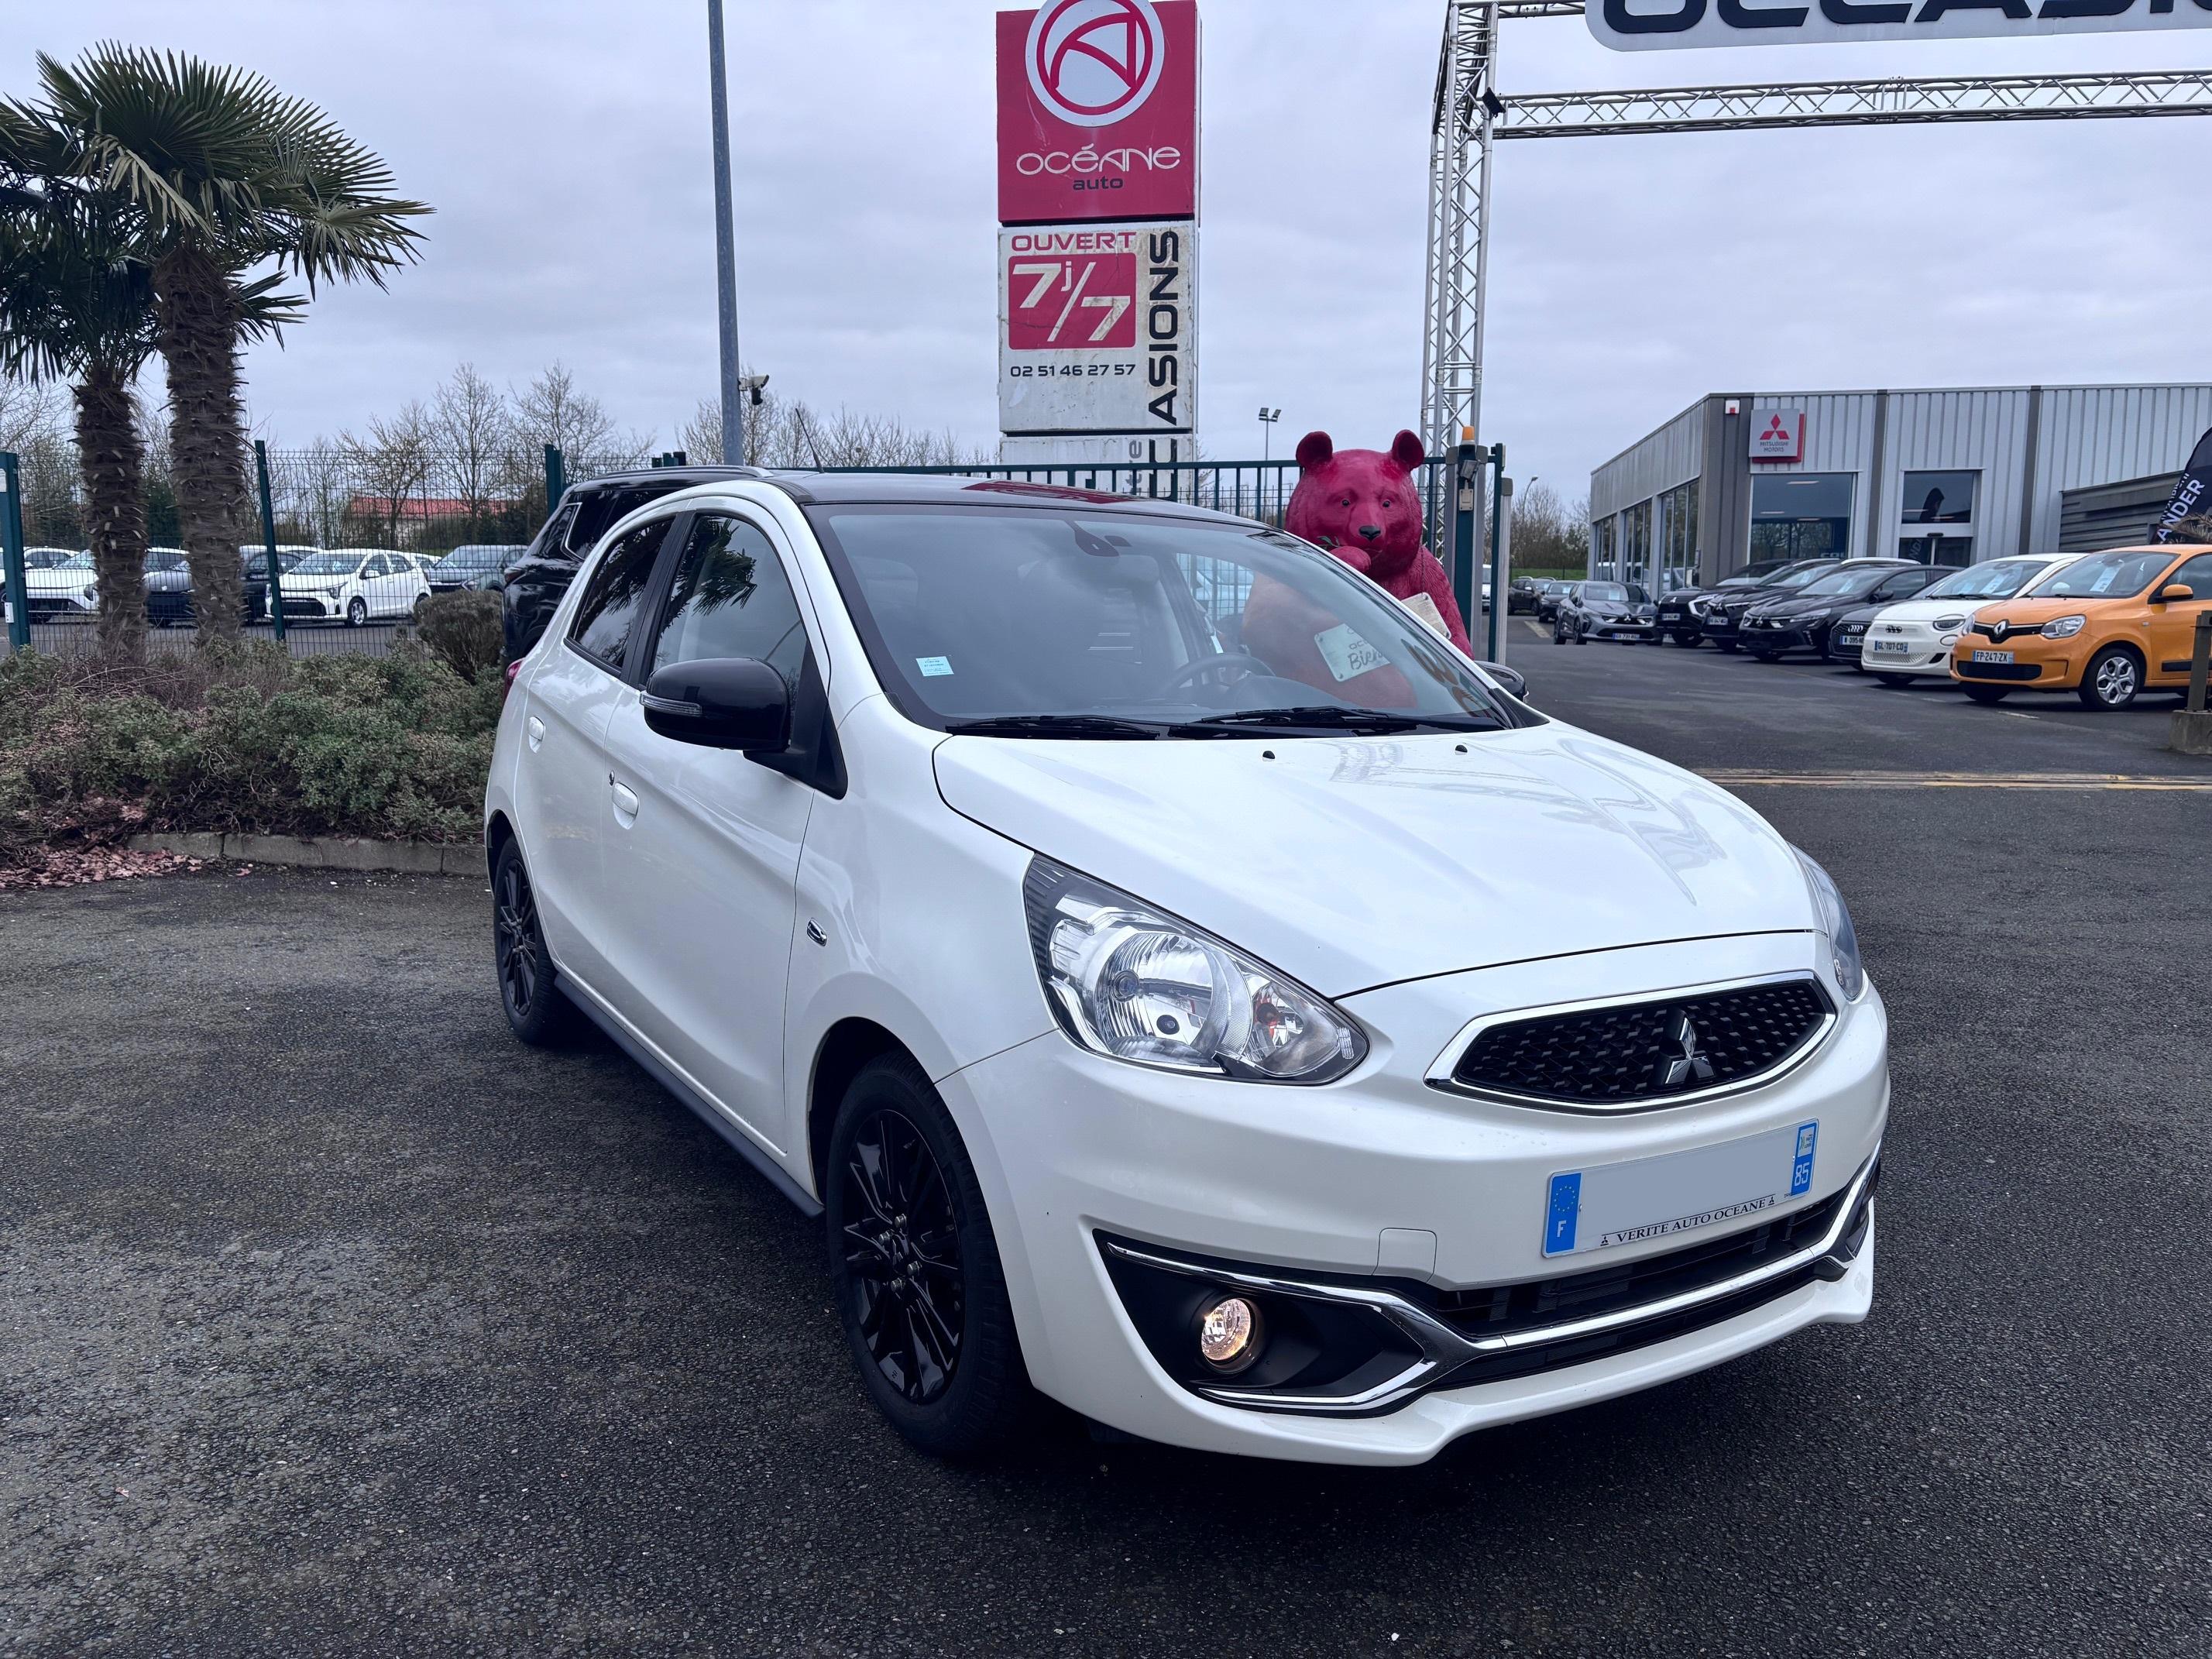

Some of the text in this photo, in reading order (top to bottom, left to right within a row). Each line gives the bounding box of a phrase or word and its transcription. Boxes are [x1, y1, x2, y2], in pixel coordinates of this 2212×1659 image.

[1073, 176, 1124, 191] auto
[1011, 232, 1136, 251] OUVERT
[1010, 364, 1136, 377] 02 51 46 27 57
[2157, 479, 2206, 543] ANDER
[1794, 1162, 1810, 1187] 85
[1557, 1220, 1567, 1238] F
[1616, 1199, 1767, 1242] VERITE AUTO OCEANE
